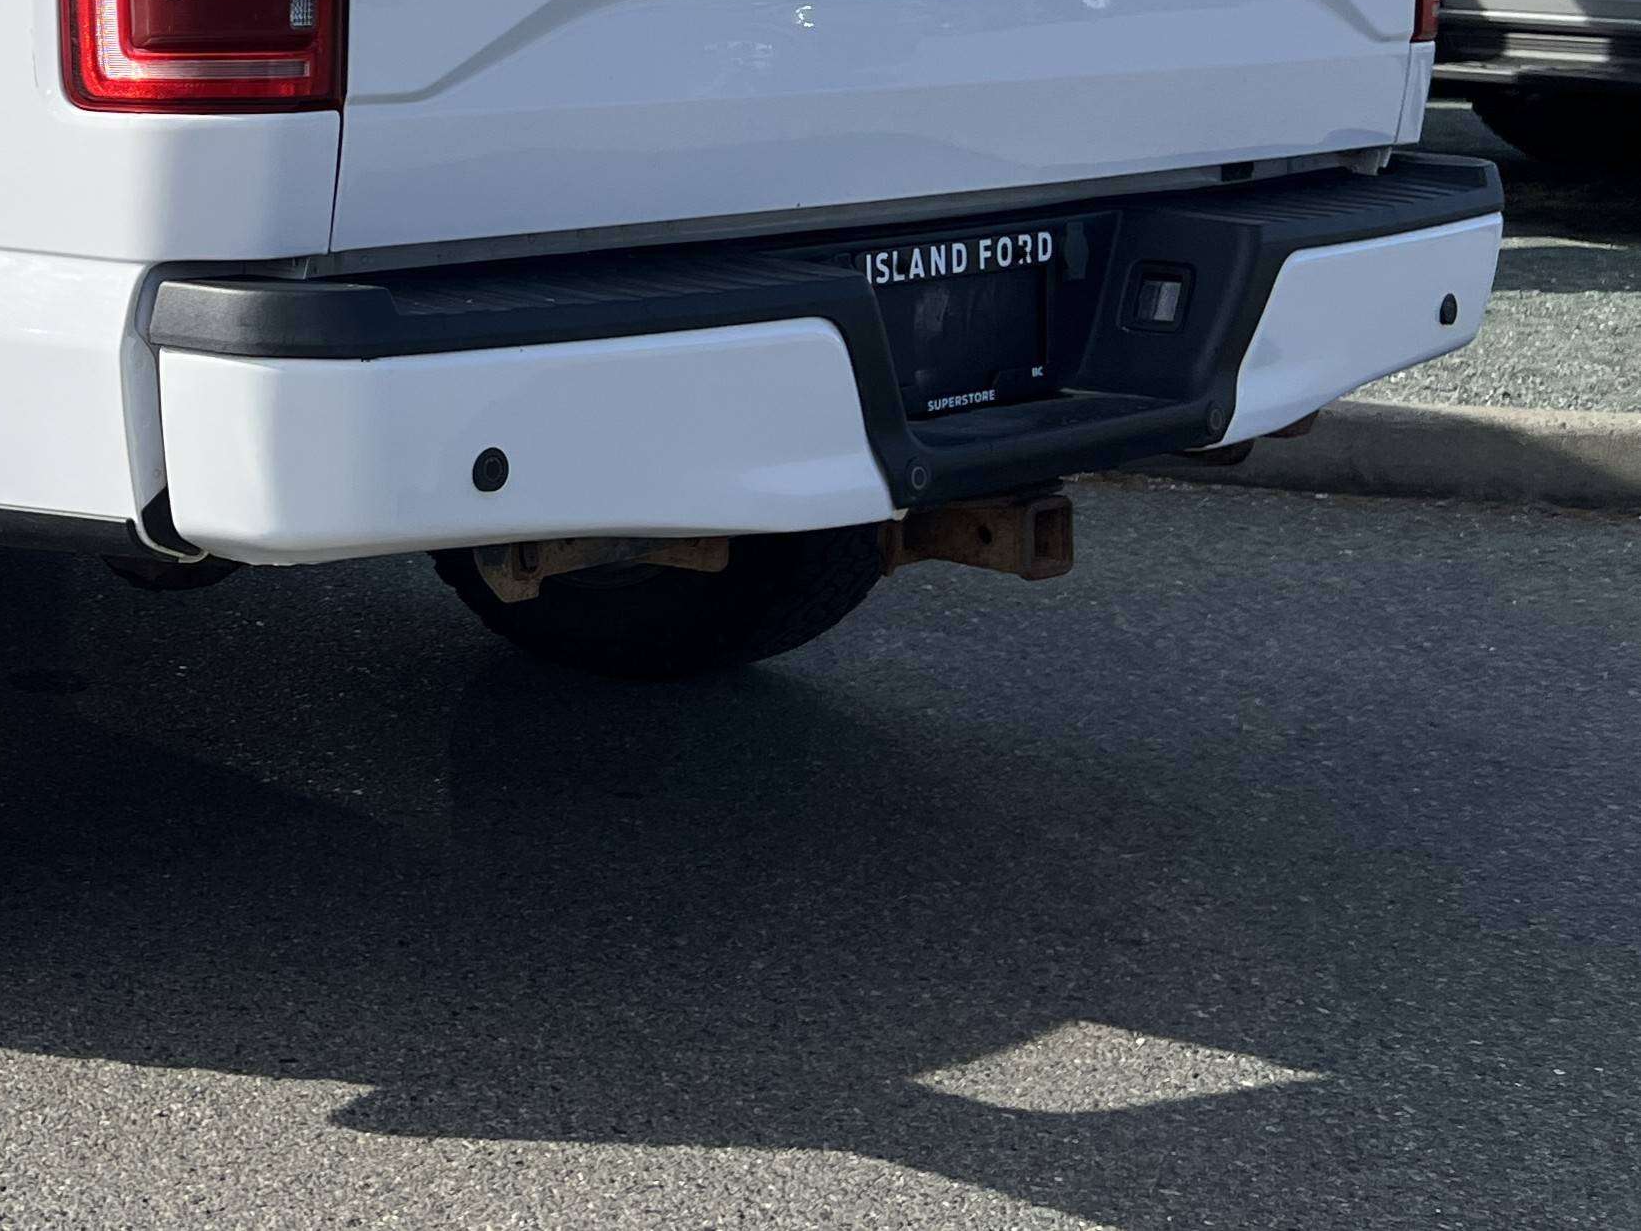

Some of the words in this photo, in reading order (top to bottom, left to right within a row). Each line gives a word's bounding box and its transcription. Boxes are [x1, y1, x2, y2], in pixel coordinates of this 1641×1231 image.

[865, 242, 967, 285] ISLAND
[978, 231, 1054, 271] FORD
[927, 388, 996, 412] SUPERSTORE
